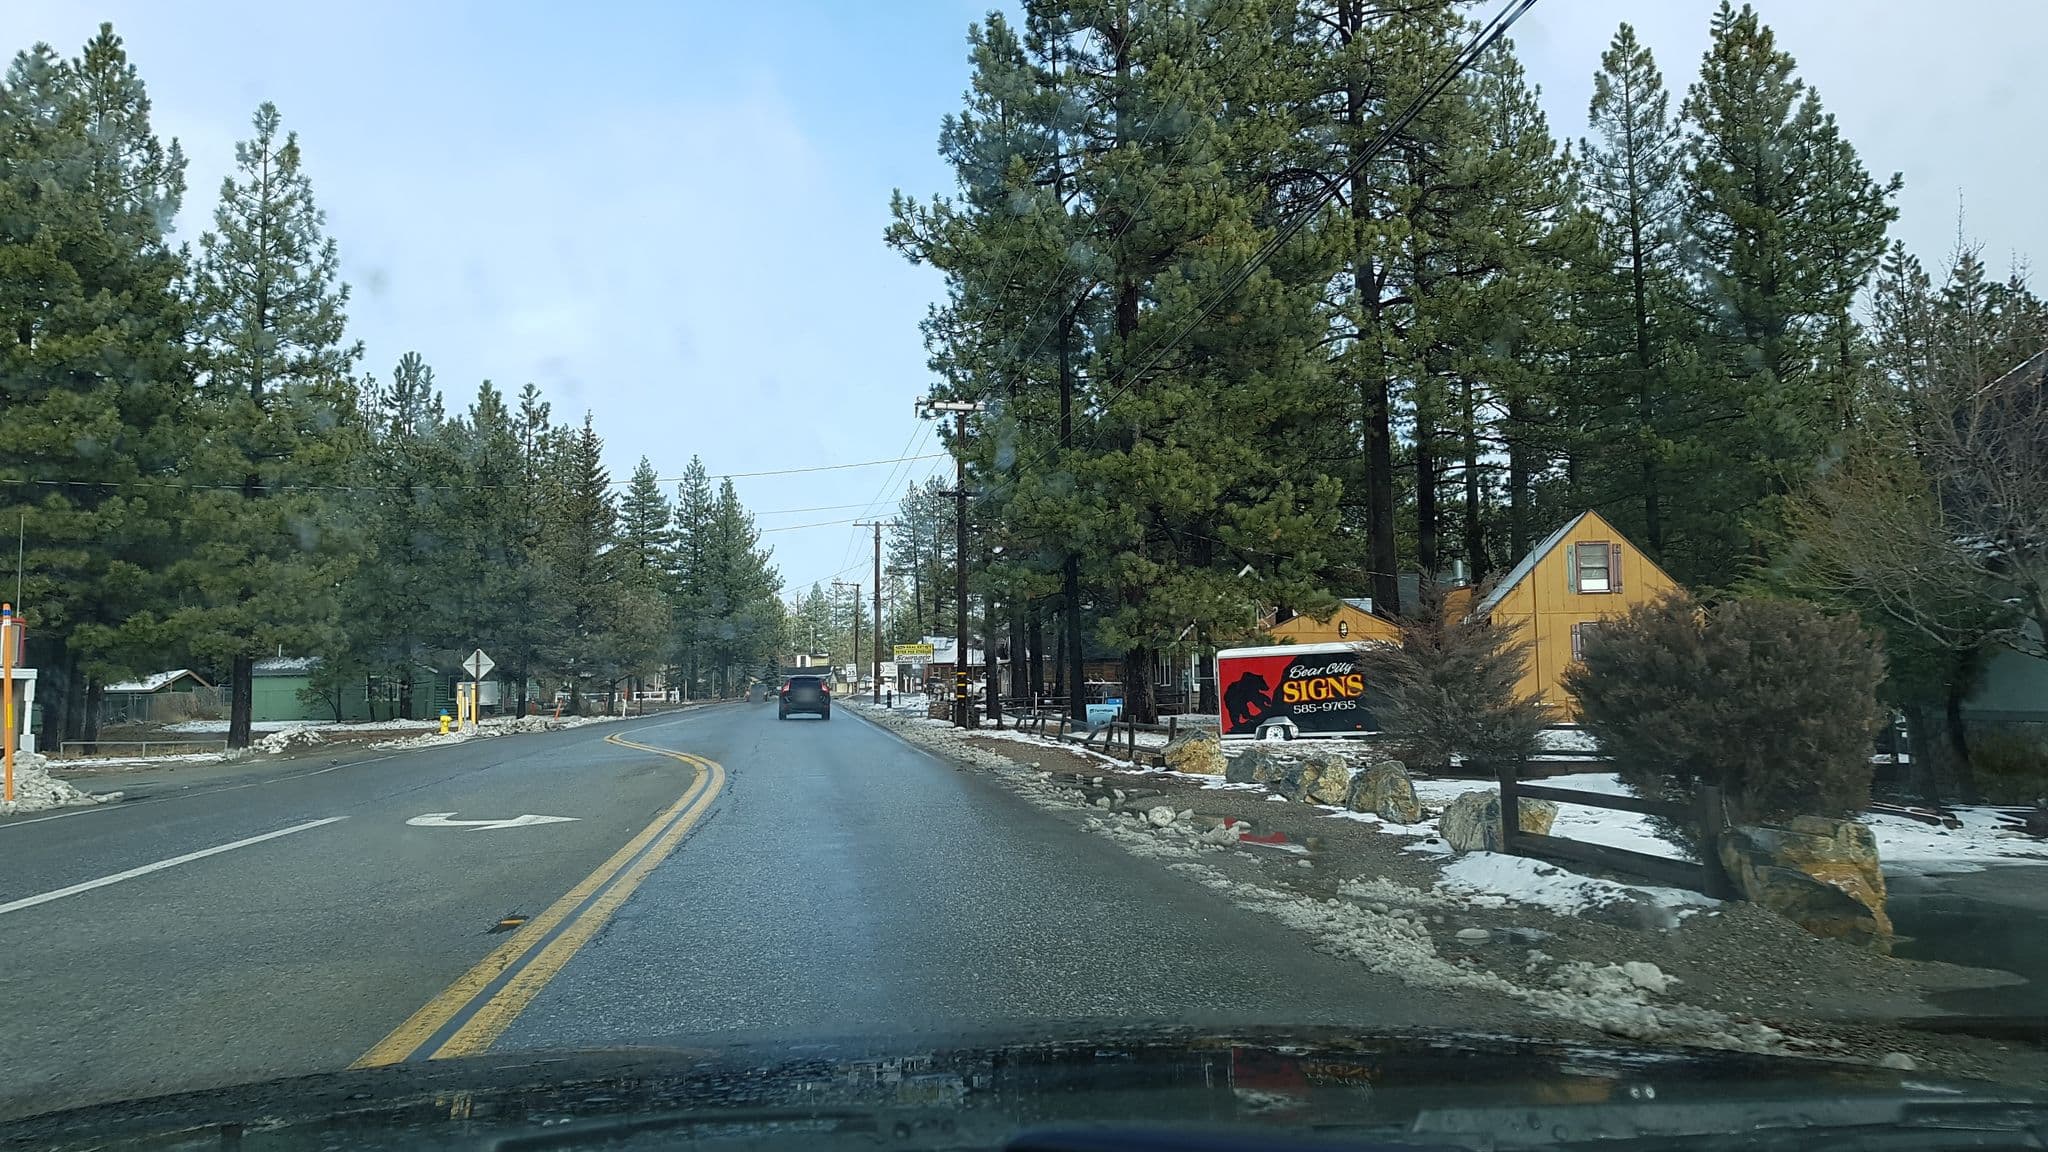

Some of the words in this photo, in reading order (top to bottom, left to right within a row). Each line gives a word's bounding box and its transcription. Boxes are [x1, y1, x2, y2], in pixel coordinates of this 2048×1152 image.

[1289, 665, 1325, 679] Bear
[1326, 662, 1354, 675] City
[1283, 674, 1364, 703] SIGNS
[1293, 700, 1356, 714] 585-9765
